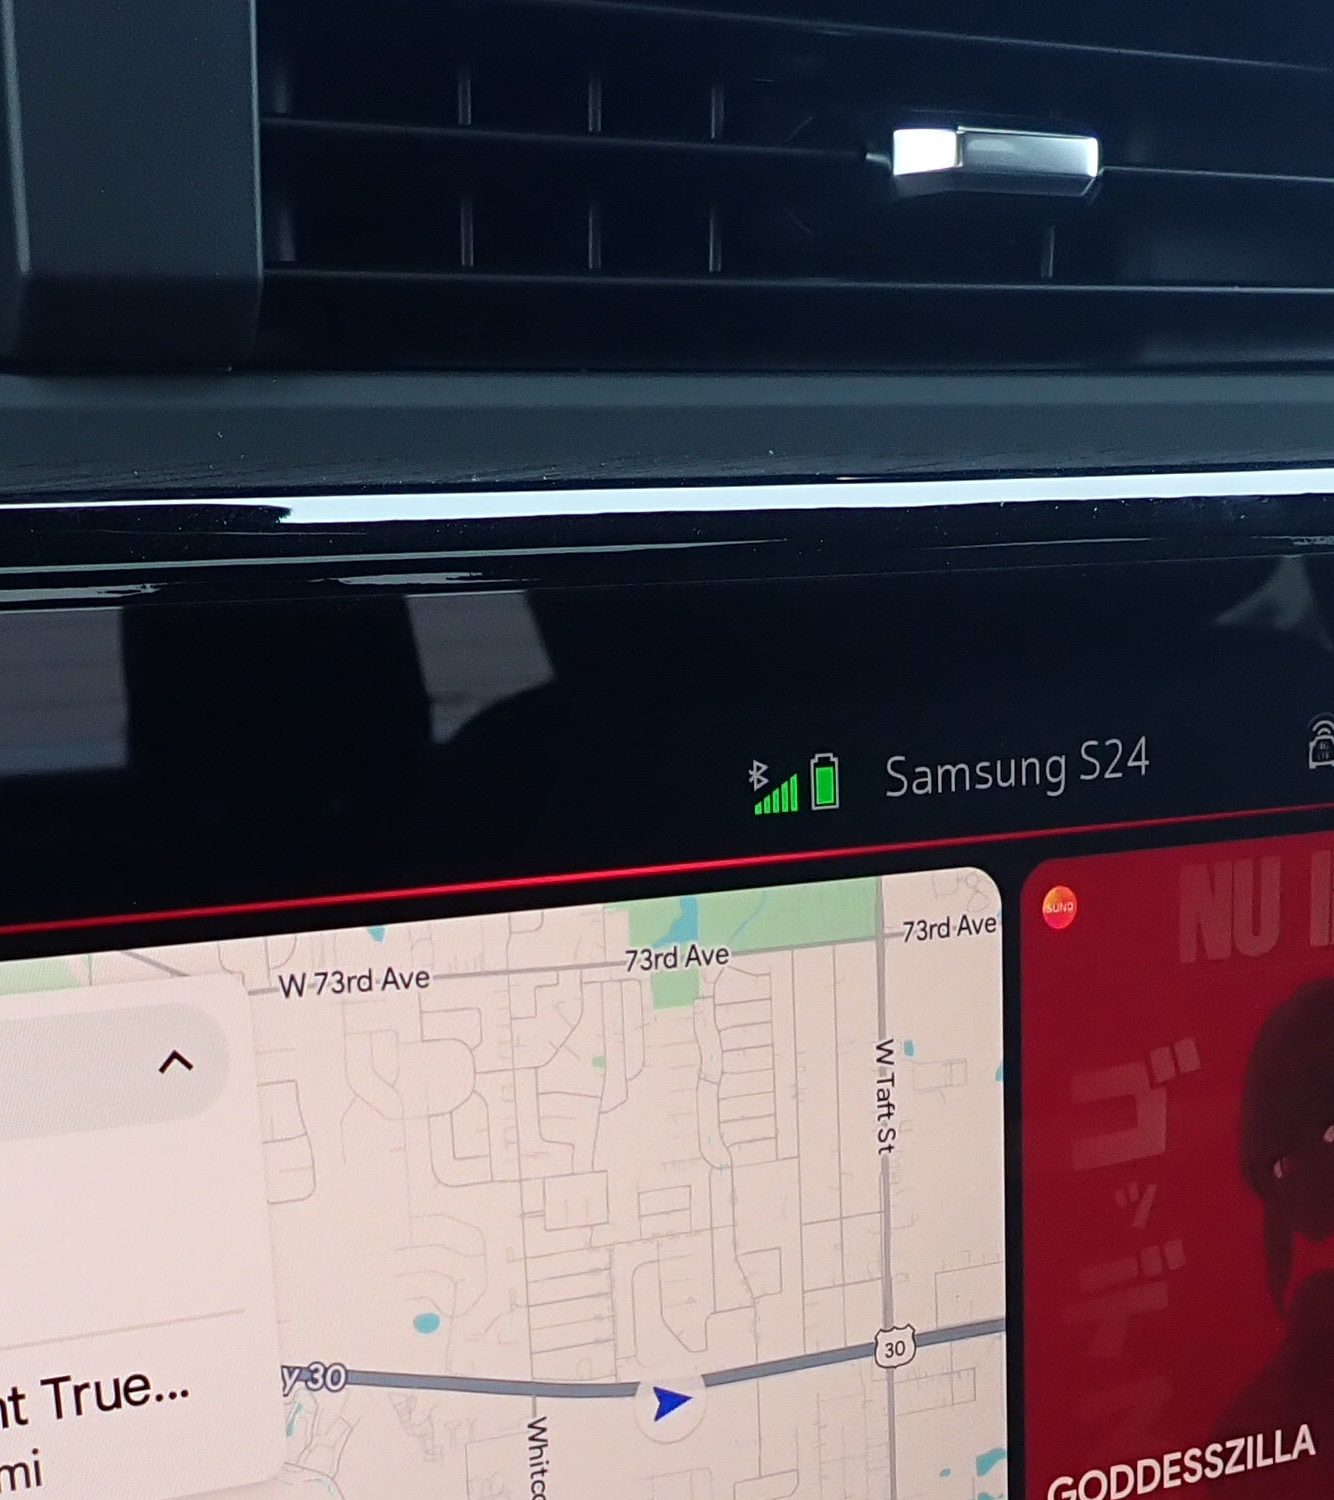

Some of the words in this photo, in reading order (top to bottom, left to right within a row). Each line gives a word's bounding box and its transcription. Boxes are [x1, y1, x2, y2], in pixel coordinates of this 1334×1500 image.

[886, 755, 1066, 797] Samsung
[1079, 736, 1150, 781] S24
[1177, 856, 1281, 964] NU
[903, 916, 950, 943] 73rd
[956, 913, 997, 938] Ave
[625, 945, 679, 972] 73rd
[684, 943, 730, 968] Ave
[279, 973, 307, 999] W
[314, 969, 372, 995] 73rd
[381, 966, 431, 992] Ave
[875, 1038, 895, 1066] W
[875, 1071, 896, 1122] Taft
[877, 1127, 897, 1155] St
[885, 1340, 906, 1358] 30
[306, 1361, 348, 1393] 30
[39, 1371, 189, 1422] True...
